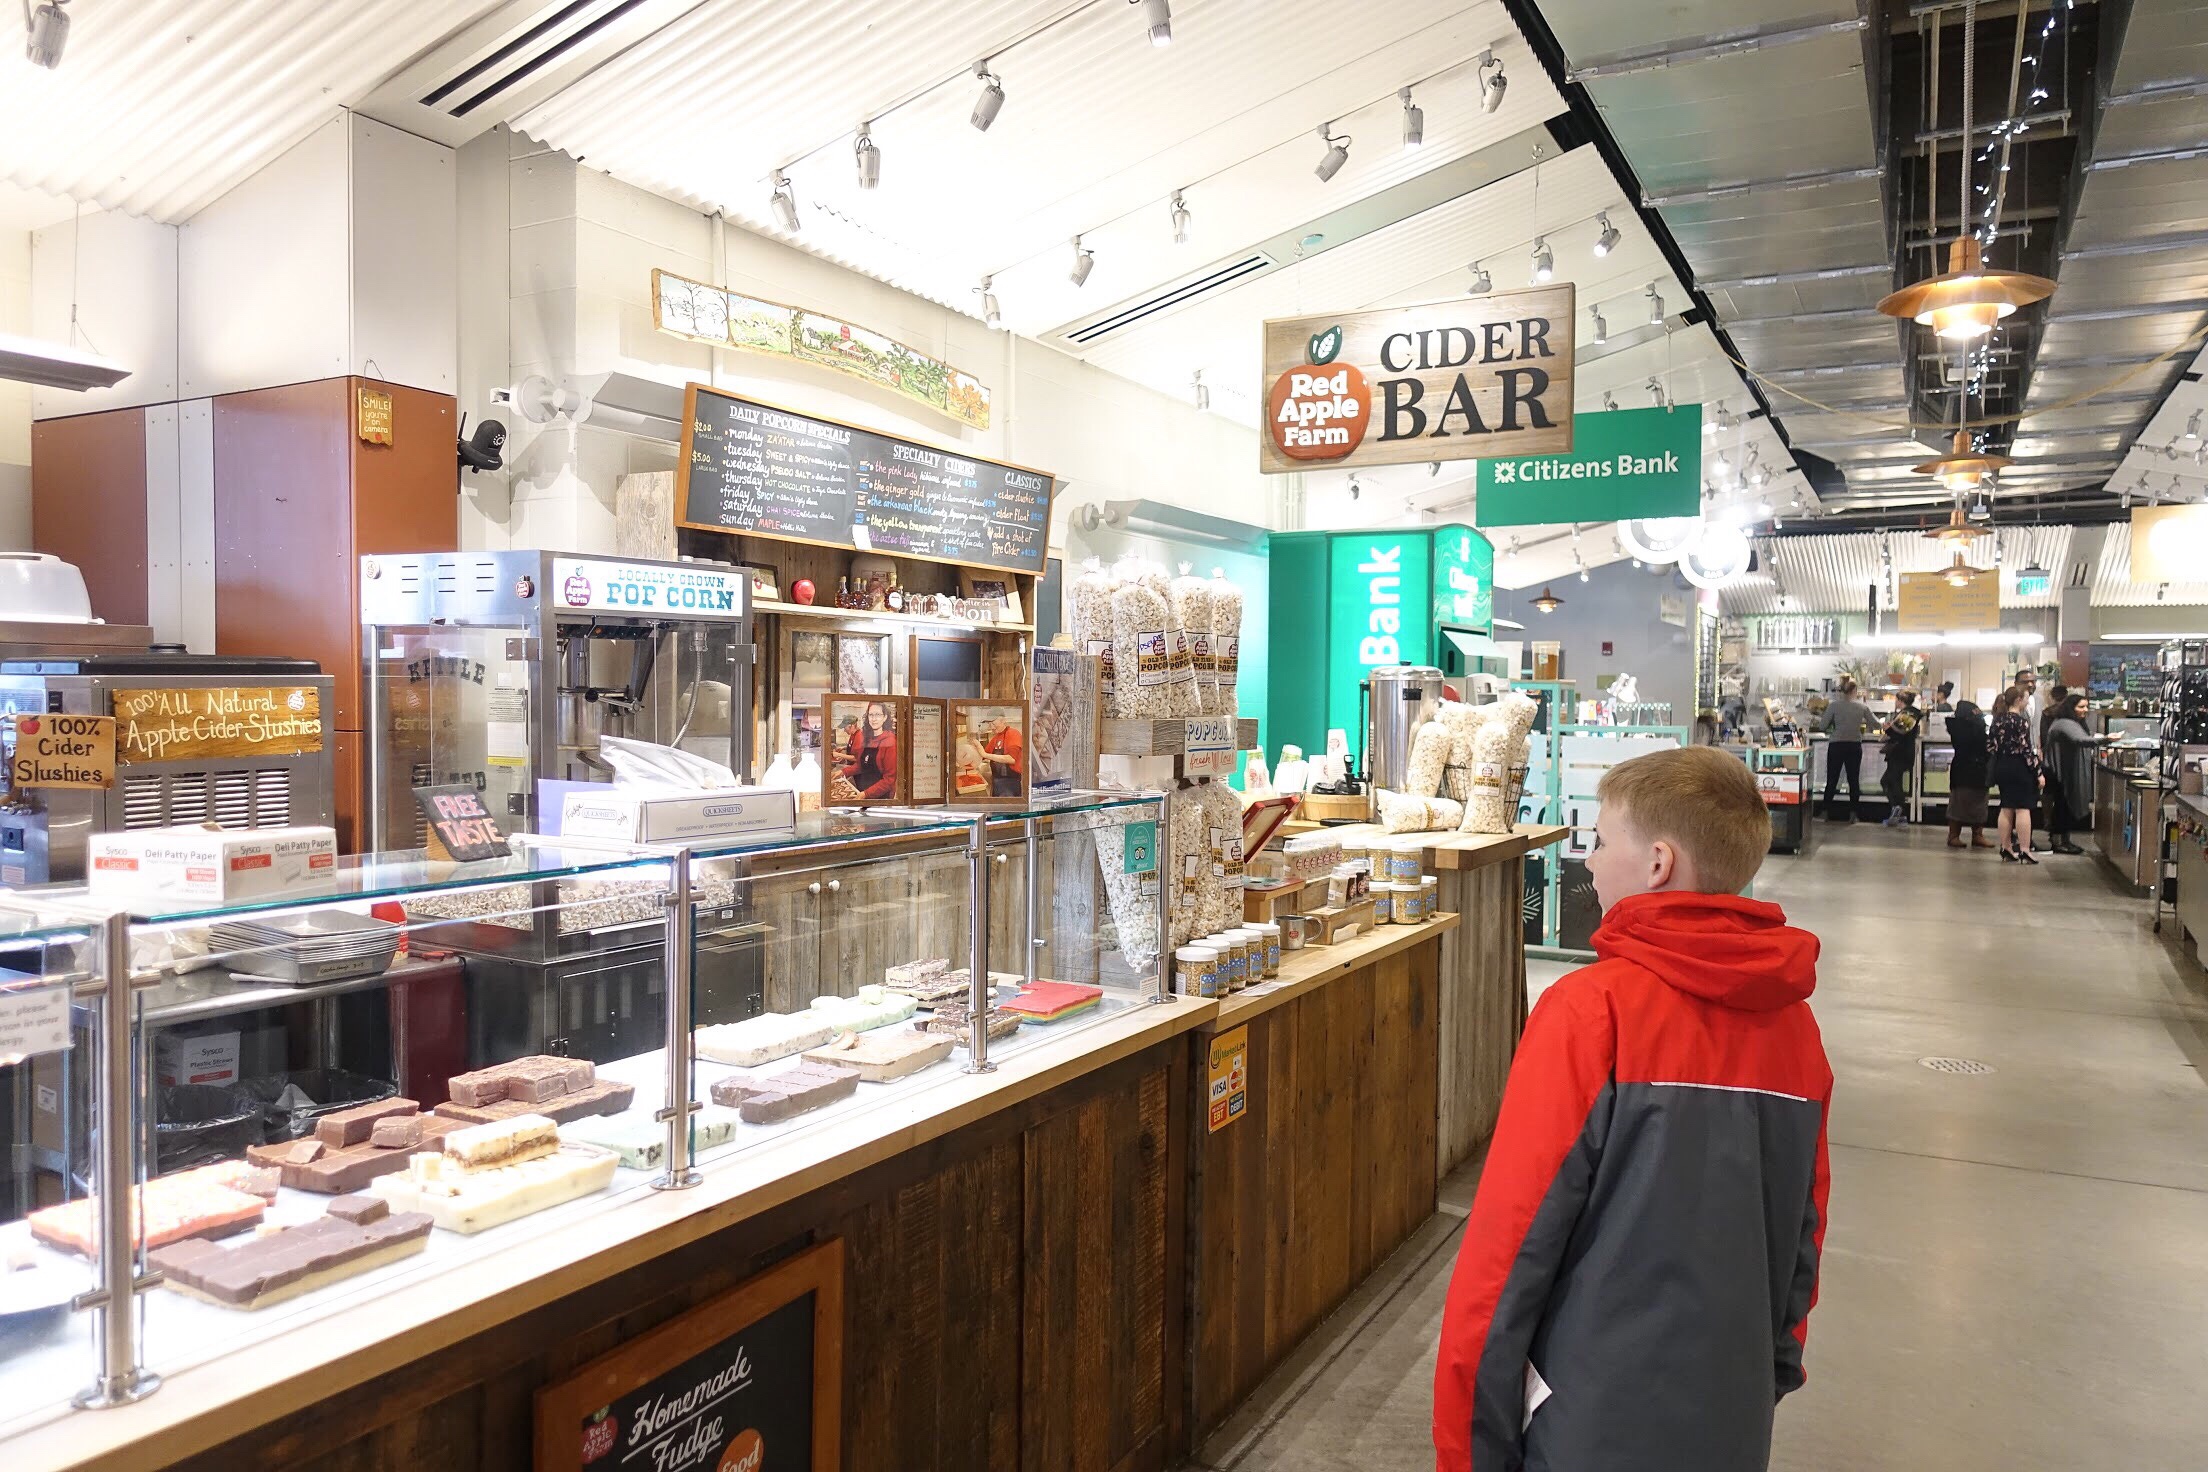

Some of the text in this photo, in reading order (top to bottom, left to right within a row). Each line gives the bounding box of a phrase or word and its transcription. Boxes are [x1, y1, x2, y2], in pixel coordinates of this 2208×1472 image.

[1380, 317, 1555, 372] CIDER
[1290, 371, 1349, 397] Red
[363, 397, 391, 412] SMILE!
[1278, 396, 1360, 425] Apple
[1377, 366, 1557, 442] BAR
[365, 411, 388, 421] you're
[730, 405, 760, 423] DAILY
[762, 413, 807, 435] POPCORN
[807, 424, 851, 444] SPECIALS
[363, 426, 389, 434] camera
[728, 427, 764, 448] monday
[1284, 426, 1349, 447] Farm
[727, 442, 763, 463] tuesday
[765, 449, 787, 462] SWEET
[789, 454, 794, 462] &
[794, 454, 812, 465] SPICY
[893, 445, 941, 467] SPECIALTY
[944, 457, 976, 476] CIDERS
[726, 460, 770, 478] wednesday
[795, 468, 812, 480] SALT
[875, 461, 887, 473] the
[888, 465, 902, 480] pink
[903, 467, 918, 484] lady
[1518, 451, 1679, 483] Citizens Bank
[724, 470, 763, 490] thursday
[764, 479, 777, 488] HOT
[778, 480, 811, 494] CHOCOLATE
[874, 479, 885, 491] the
[885, 483, 908, 498] ginger
[909, 485, 925, 499] gold
[1005, 472, 1042, 490] CLASSICS
[722, 485, 750, 503] friday
[756, 490, 774, 502] SPICY
[998, 489, 1014, 501] cider
[722, 500, 763, 518] saturday
[766, 505, 781, 514] CHAI
[783, 507, 801, 516] SPICE
[870, 495, 882, 507] the
[913, 500, 934, 515] black
[996, 507, 1013, 519] cider
[720, 514, 754, 530] sunday
[758, 519, 781, 530] MAPLE
[871, 515, 882, 528] the
[881, 517, 909, 532] yellow
[1012, 529, 1024, 542] shot
[618, 569, 725, 588] LOCALLY GROWN
[606, 582, 734, 611] POP CORN
[1358, 545, 1401, 665] Bank
[407, 656, 486, 686] KETTLE
[1141, 661, 1168, 672] POPCO
[126, 690, 278, 717] 100% All Natural
[50, 718, 101, 736] 100%
[127, 714, 322, 758] Apple Cider Slushies
[38, 738, 95, 756] Cider
[16, 760, 103, 783] Slushies
[433, 794, 486, 819] FREE
[704, 806, 742, 816] QUICKSHEETS
[436, 818, 505, 848] TASTE
[105, 845, 128, 856] Sysco
[240, 845, 262, 856] Sysco
[274, 839, 333, 852] Deli Patty Paper
[101, 858, 133, 871] Classic
[145, 849, 217, 862] Deli Patty Paper
[238, 857, 267, 870] Classic
[201, 1047, 224, 1057] Sysco
[1212, 1080, 1227, 1096] VISA
[1213, 1108, 1224, 1123] EBT
[1230, 1100, 1243, 1114] DEBIT
[628, 1345, 752, 1446] Homemade
[589, 1418, 608, 1440] Red
[652, 1415, 724, 1472] Fudge
